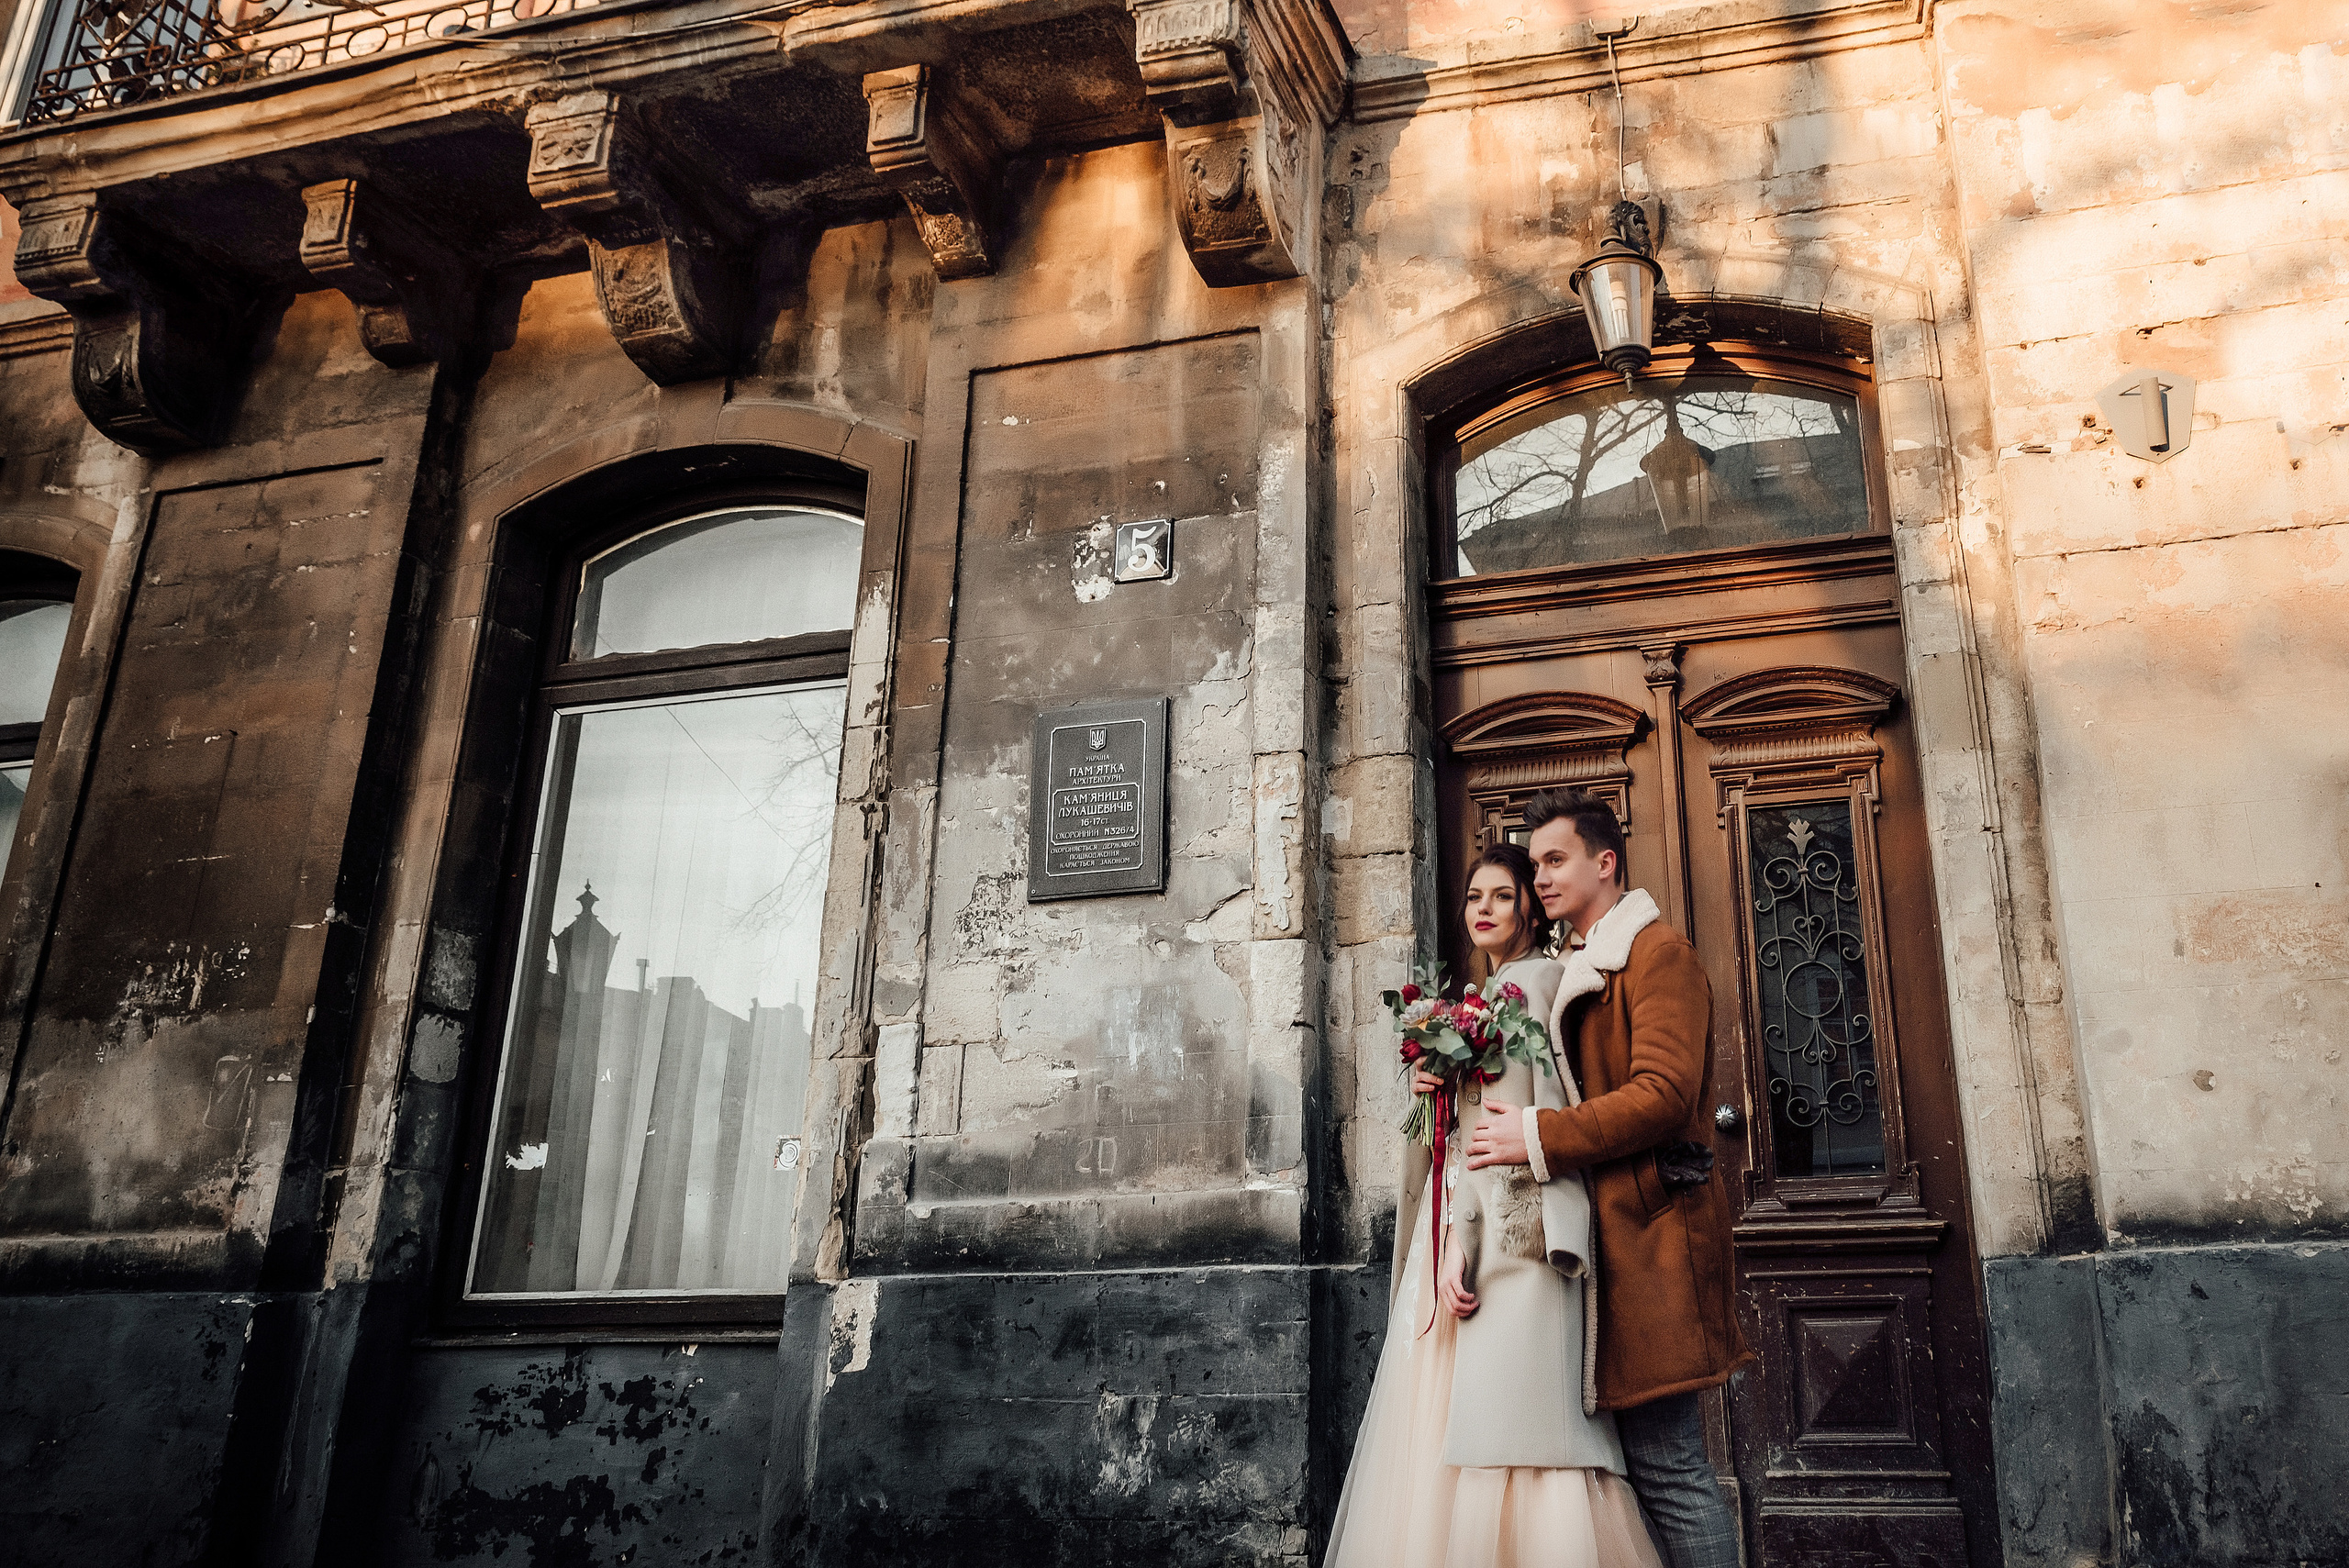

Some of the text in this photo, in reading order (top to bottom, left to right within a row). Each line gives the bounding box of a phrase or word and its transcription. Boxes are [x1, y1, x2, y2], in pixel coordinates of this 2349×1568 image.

[1128, 526, 1156, 572] 5
[1069, 762, 1125, 777] ПАМ'ЯТКА
[1072, 774, 1121, 785] АРХІТЕКТУРИ
[1063, 790, 1128, 806] КАМ'ЯНИЦЯ
[1058, 801, 1133, 817] ЛУКАШЕВИЧІВ
[1055, 828, 1099, 840] ОХОРОННИЙ
[1102, 840, 1140, 850] ДЕРЖАВОЮ
[1069, 851, 1120, 861] ПОШКОДЖЕННЯ
[1100, 857, 1130, 865] ЗАКОНОМ
